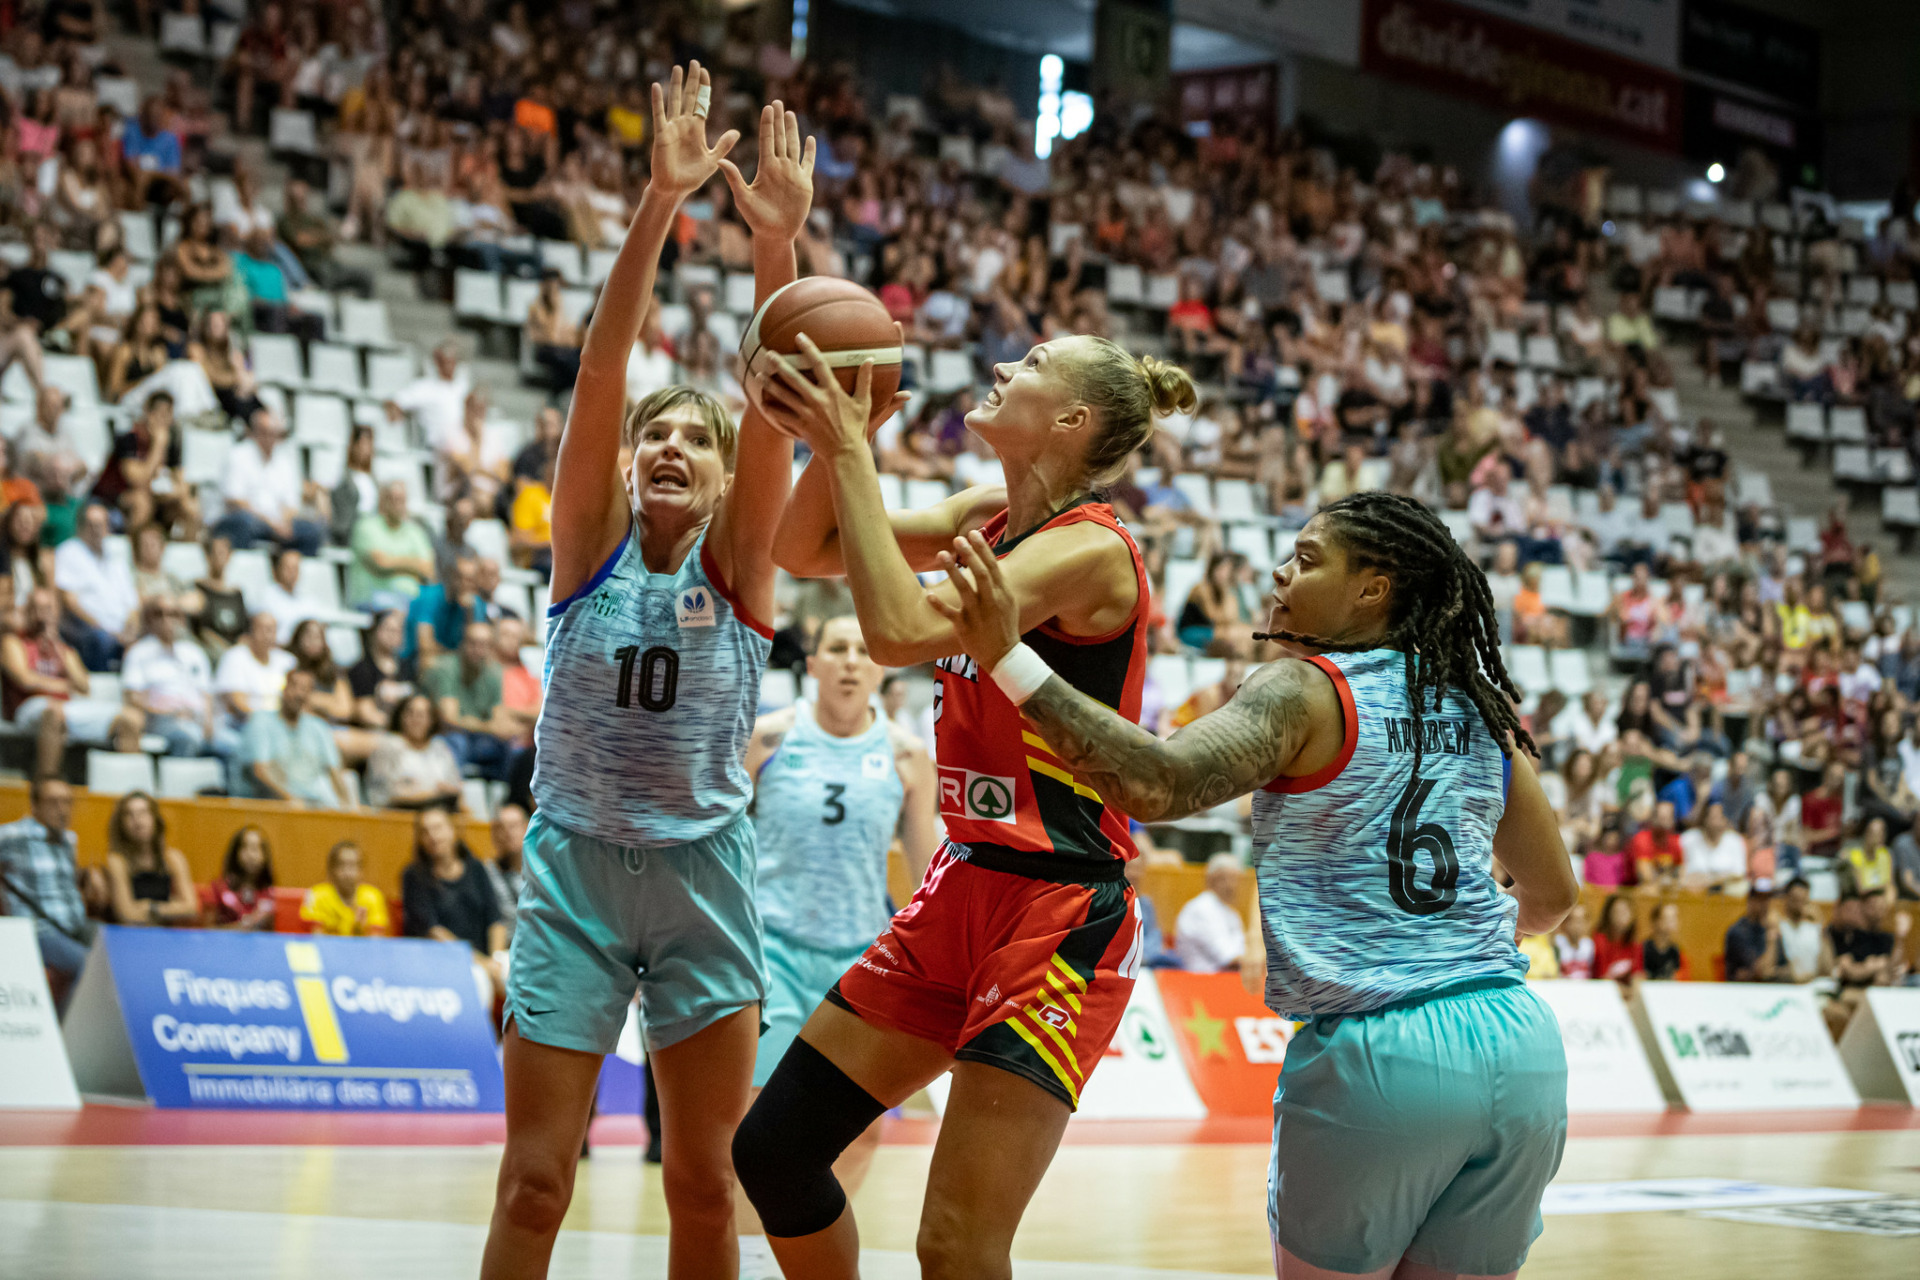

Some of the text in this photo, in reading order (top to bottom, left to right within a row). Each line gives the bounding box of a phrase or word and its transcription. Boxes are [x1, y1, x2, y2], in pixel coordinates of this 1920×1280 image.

[613, 645, 680, 713] 10
[821, 782, 846, 826] 3
[1386, 778, 1460, 916] 6
[162, 968, 463, 1023] Finques Ceigrup
[152, 1014, 301, 1062] Company
[335, 1074, 380, 1105] des
[383, 1075, 415, 1105] de
